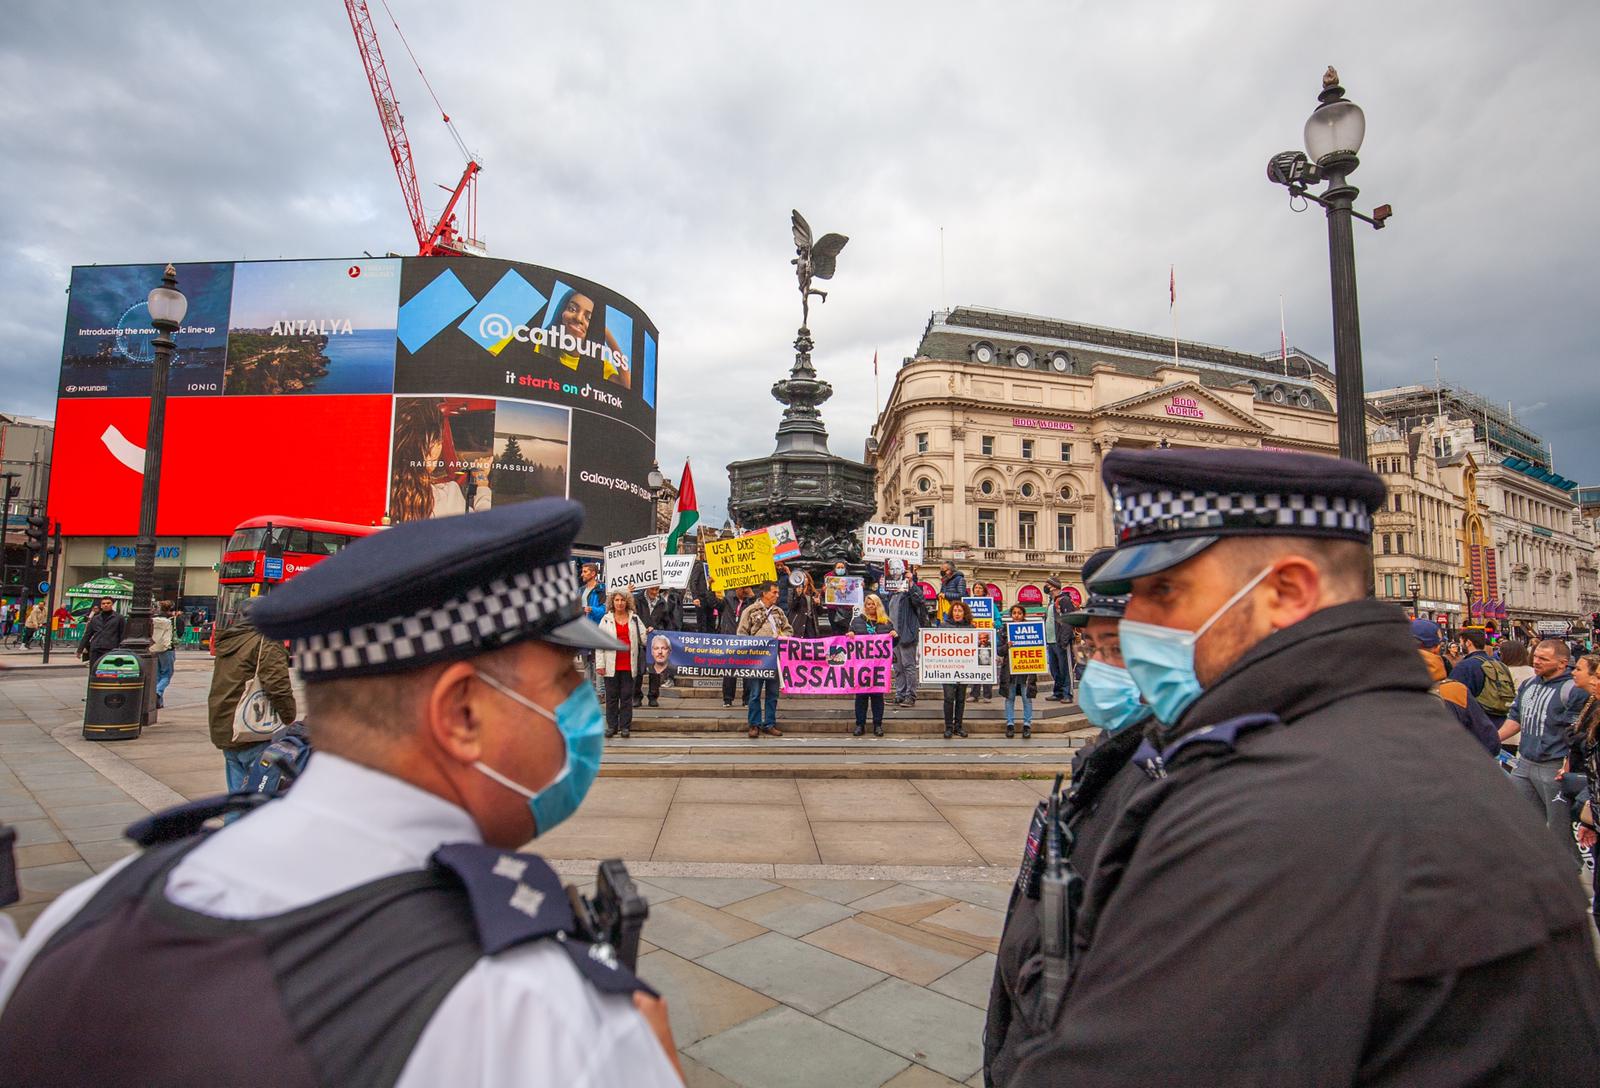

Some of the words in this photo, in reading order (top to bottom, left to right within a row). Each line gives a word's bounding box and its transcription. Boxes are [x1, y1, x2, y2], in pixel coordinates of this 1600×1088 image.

[79, 328, 124, 336] Introducing
[125, 327, 138, 335] the
[187, 325, 216, 335] line-up
[270, 319, 353, 336] ANTALYA
[479, 312, 629, 371] @catburnss
[187, 383, 217, 391] IONIQ
[505, 370, 516, 384] it
[518, 374, 560, 391] starts
[562, 383, 578, 395] on
[593, 389, 623, 408] TikTok
[1172, 396, 1198, 408] BODY
[1165, 405, 1204, 419] WORLDS
[1013, 418, 1037, 428] BODY
[1038, 419, 1075, 431] WORLDS
[448, 461, 489, 469] AROUND
[580, 470, 615, 490] Galaxy
[615, 478, 630, 491] S20+
[630, 483, 638, 495] 5G
[867, 525, 887, 536] NO
[891, 528, 919, 539] ONE
[712, 543, 732, 555] USA
[737, 538, 754, 551] DOES
[867, 537, 920, 549] HARMED
[120, 547, 180, 558] BAAYS
[608, 548, 626, 559] BENT
[628, 541, 657, 555] JUDGES
[878, 548, 919, 557] WIKILEAKS
[629, 559, 646, 567] killing
[664, 559, 690, 568] Julian
[721, 554, 735, 565] NOT
[737, 551, 756, 562] HAVE
[715, 563, 756, 577] UNIVERSAL
[610, 569, 659, 588] ASSANGE
[723, 572, 770, 588] JURISDICTION
[968, 600, 987, 608] JAIL
[1014, 626, 1038, 634] JAIL
[678, 636, 702, 644] '1984'
[703, 637, 710, 645] IS
[711, 638, 723, 646] SO
[724, 639, 776, 647] YESTERDAY...
[924, 633, 974, 644] Political
[778, 640, 826, 661] FREE
[846, 640, 891, 659] PRESS
[924, 646, 976, 657] Prisoner
[1013, 649, 1043, 658] FREE
[677, 666, 699, 675] FREE
[701, 668, 732, 676] JULIAN
[733, 669, 775, 678] ASSANGE
[783, 665, 886, 688] ASSANGE
[924, 670, 951, 679] Julian
[954, 671, 992, 680] Assange
